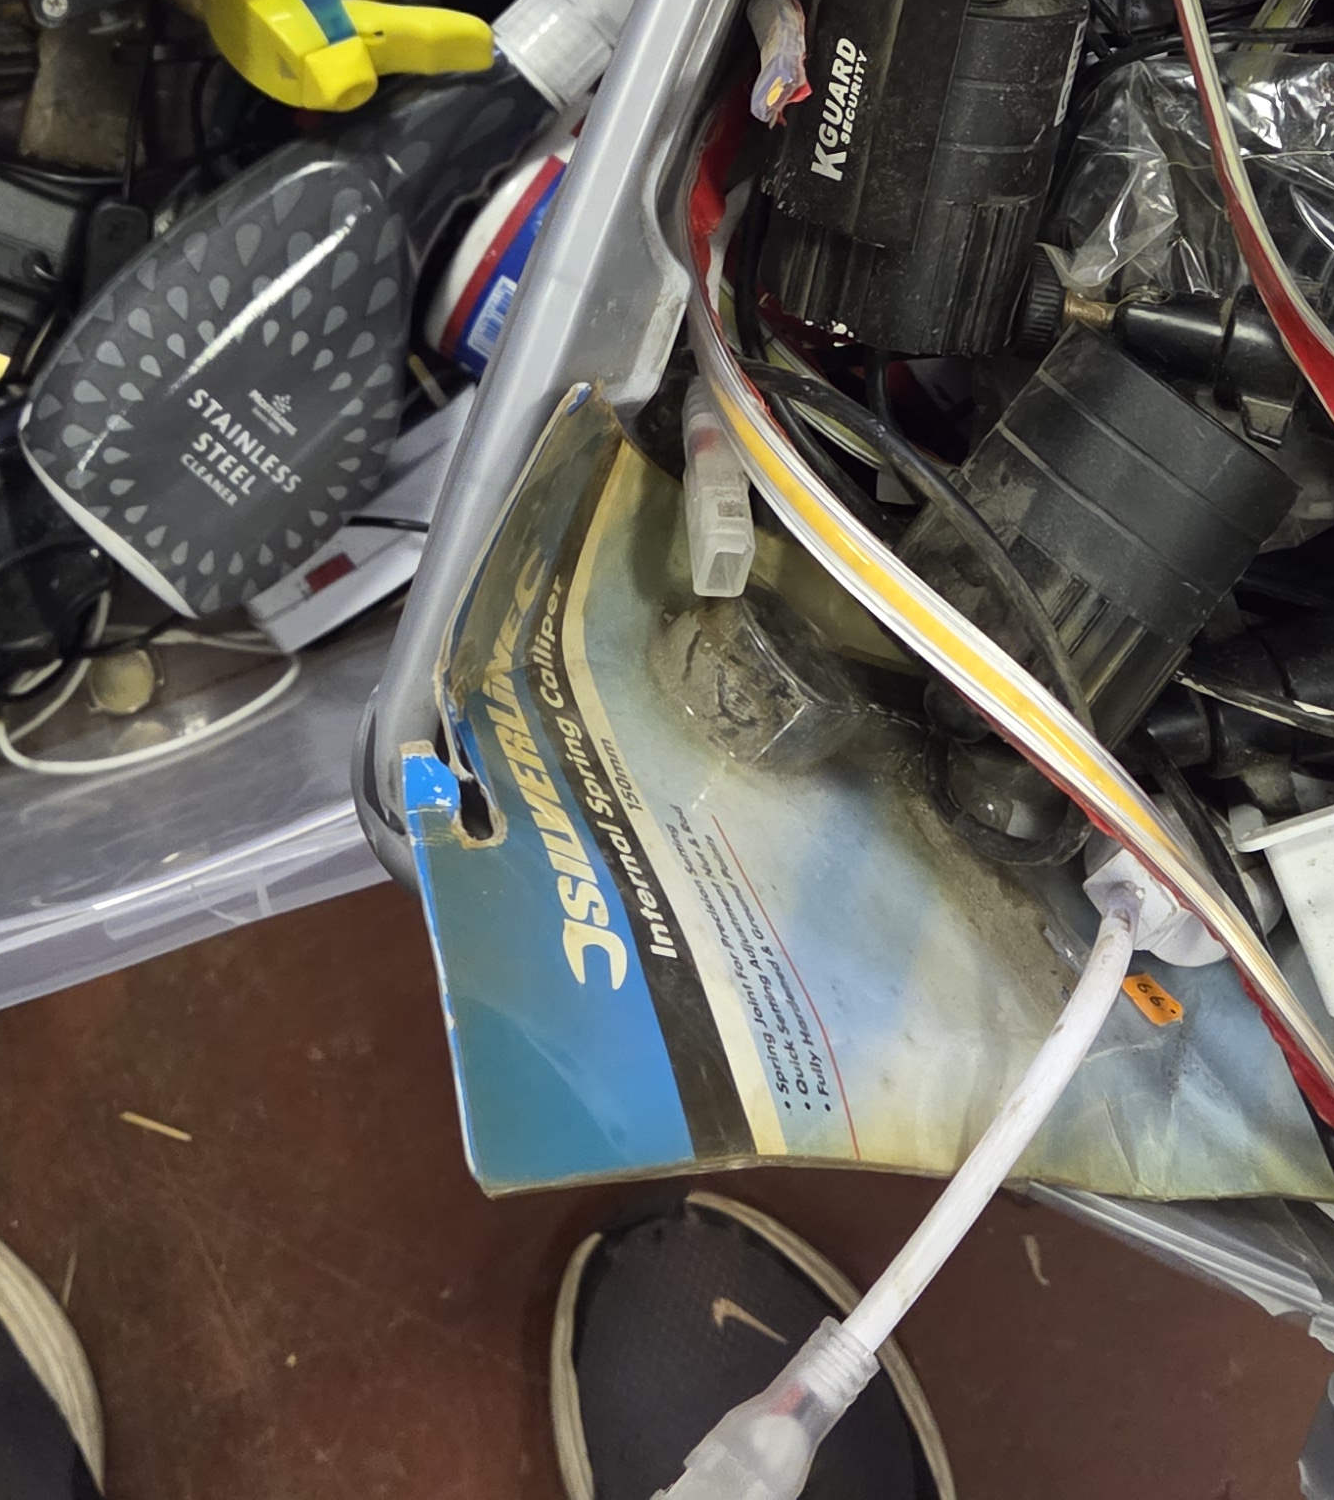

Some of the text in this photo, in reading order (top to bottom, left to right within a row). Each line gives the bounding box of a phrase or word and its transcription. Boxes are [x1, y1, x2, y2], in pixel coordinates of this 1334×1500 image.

[840, 49, 867, 145] SECURITY
[180, 453, 238, 506] CLEANER
[187, 389, 302, 493] STAINLESS
[192, 432, 256, 495] STEEL
[532, 574, 678, 959] Internal Spring Calliper
[601, 737, 644, 812] 150mm
[667, 822, 790, 1094] Spring Joint For Precision Setting
[669, 803, 809, 1095] Quick Setting Adjustment Nut & Rod
[705, 834, 829, 1096] Fully Hardened & Ground Points
